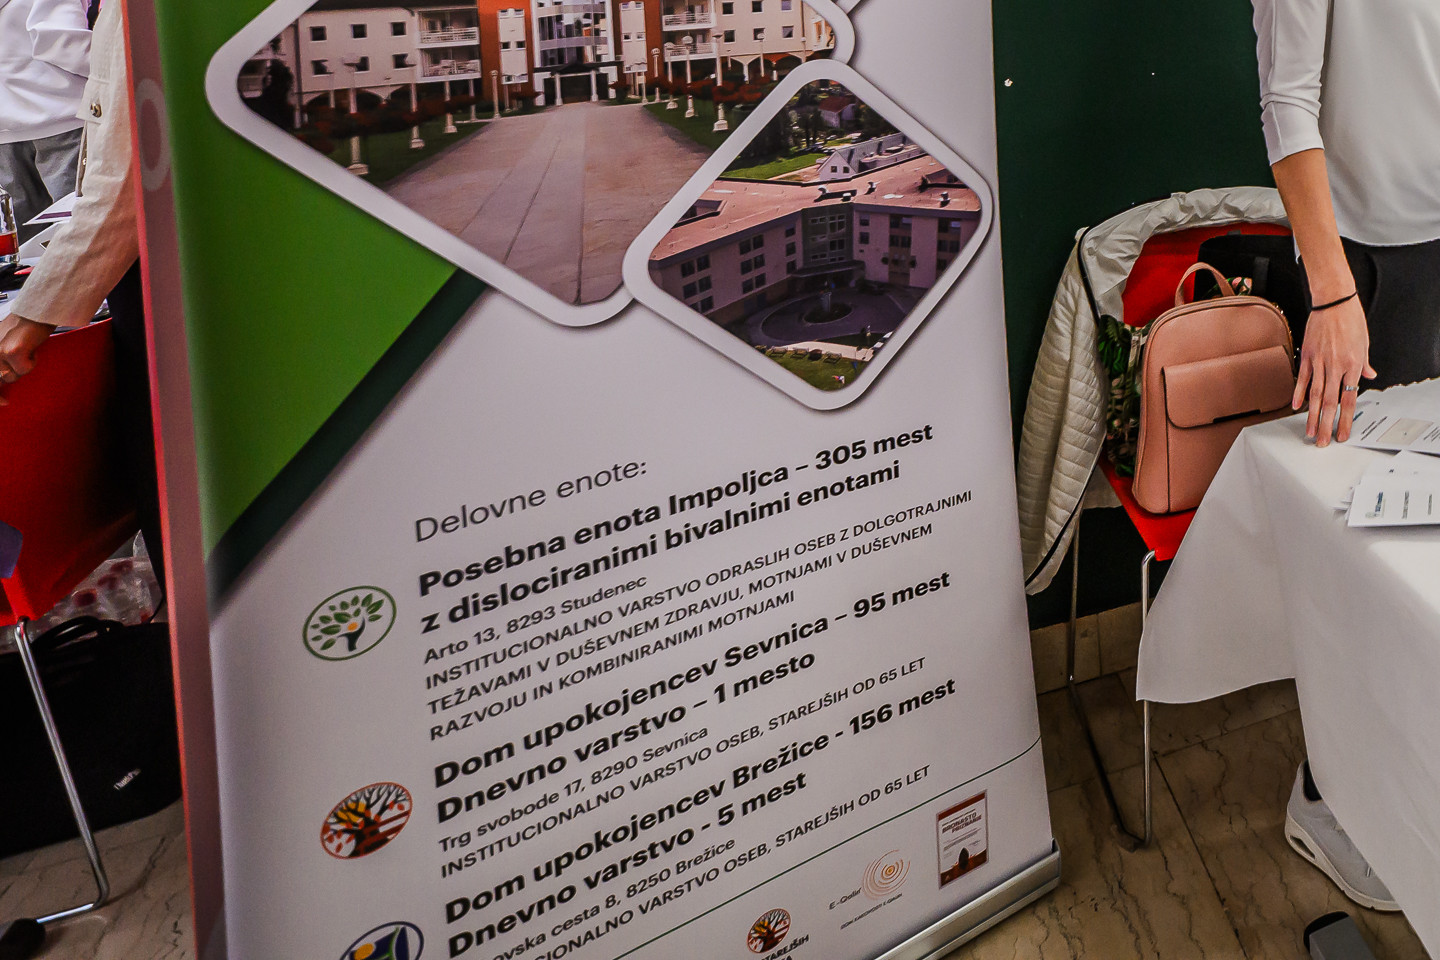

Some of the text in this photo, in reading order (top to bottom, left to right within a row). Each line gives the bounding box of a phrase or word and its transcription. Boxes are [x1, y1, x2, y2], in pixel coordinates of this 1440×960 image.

[416, 462, 646, 542] Delovne enote:
[419, 425, 933, 596] Posebna enota Impoljca 305 mest
[421, 460, 899, 634] z dislociranimi bivalnimi enotami
[425, 577, 646, 664] Arto 13, 8293 Studenec
[426, 491, 971, 689] INSTITUCIONALNO VARSTVO ODRASLIH OSEB Z DOLGOTRAJNIMI
[427, 523, 932, 714] TEŽAVAMI V DUŠEVNEM ZDRAVJU, MOTNJAMI V DUŠEVNEM
[430, 590, 794, 741] RAZVOJU IN KOMBINIRANIMI MOTNJAMI
[435, 572, 950, 788] Dom upokojencev Sevnica 95 mest
[438, 654, 815, 823] Dnevno varstvo 1 mesto
[439, 728, 708, 852] Trg svobode 17, 8290 Sevnica
[442, 657, 925, 878] INSTITUCIONALNO VARSTVO OSEB, STAREJŠIH OD 65 LET
[446, 679, 955, 924] Dom upokojencev Brežice 156 mest
[639, 868, 719, 914] VARSTVO
[724, 843, 771, 872] OSEB,
[776, 800, 854, 847] STAREJŠIH
[858, 789, 880, 806] OD
[885, 778, 902, 794] 65
[907, 765, 930, 785] LET
[449, 773, 806, 958] Dnevno varstvo 5 mest
[551, 905, 600, 936] cesta
[605, 895, 621, 908] 8,
[626, 868, 671, 898] 8250
[676, 840, 735, 875] Brežice
